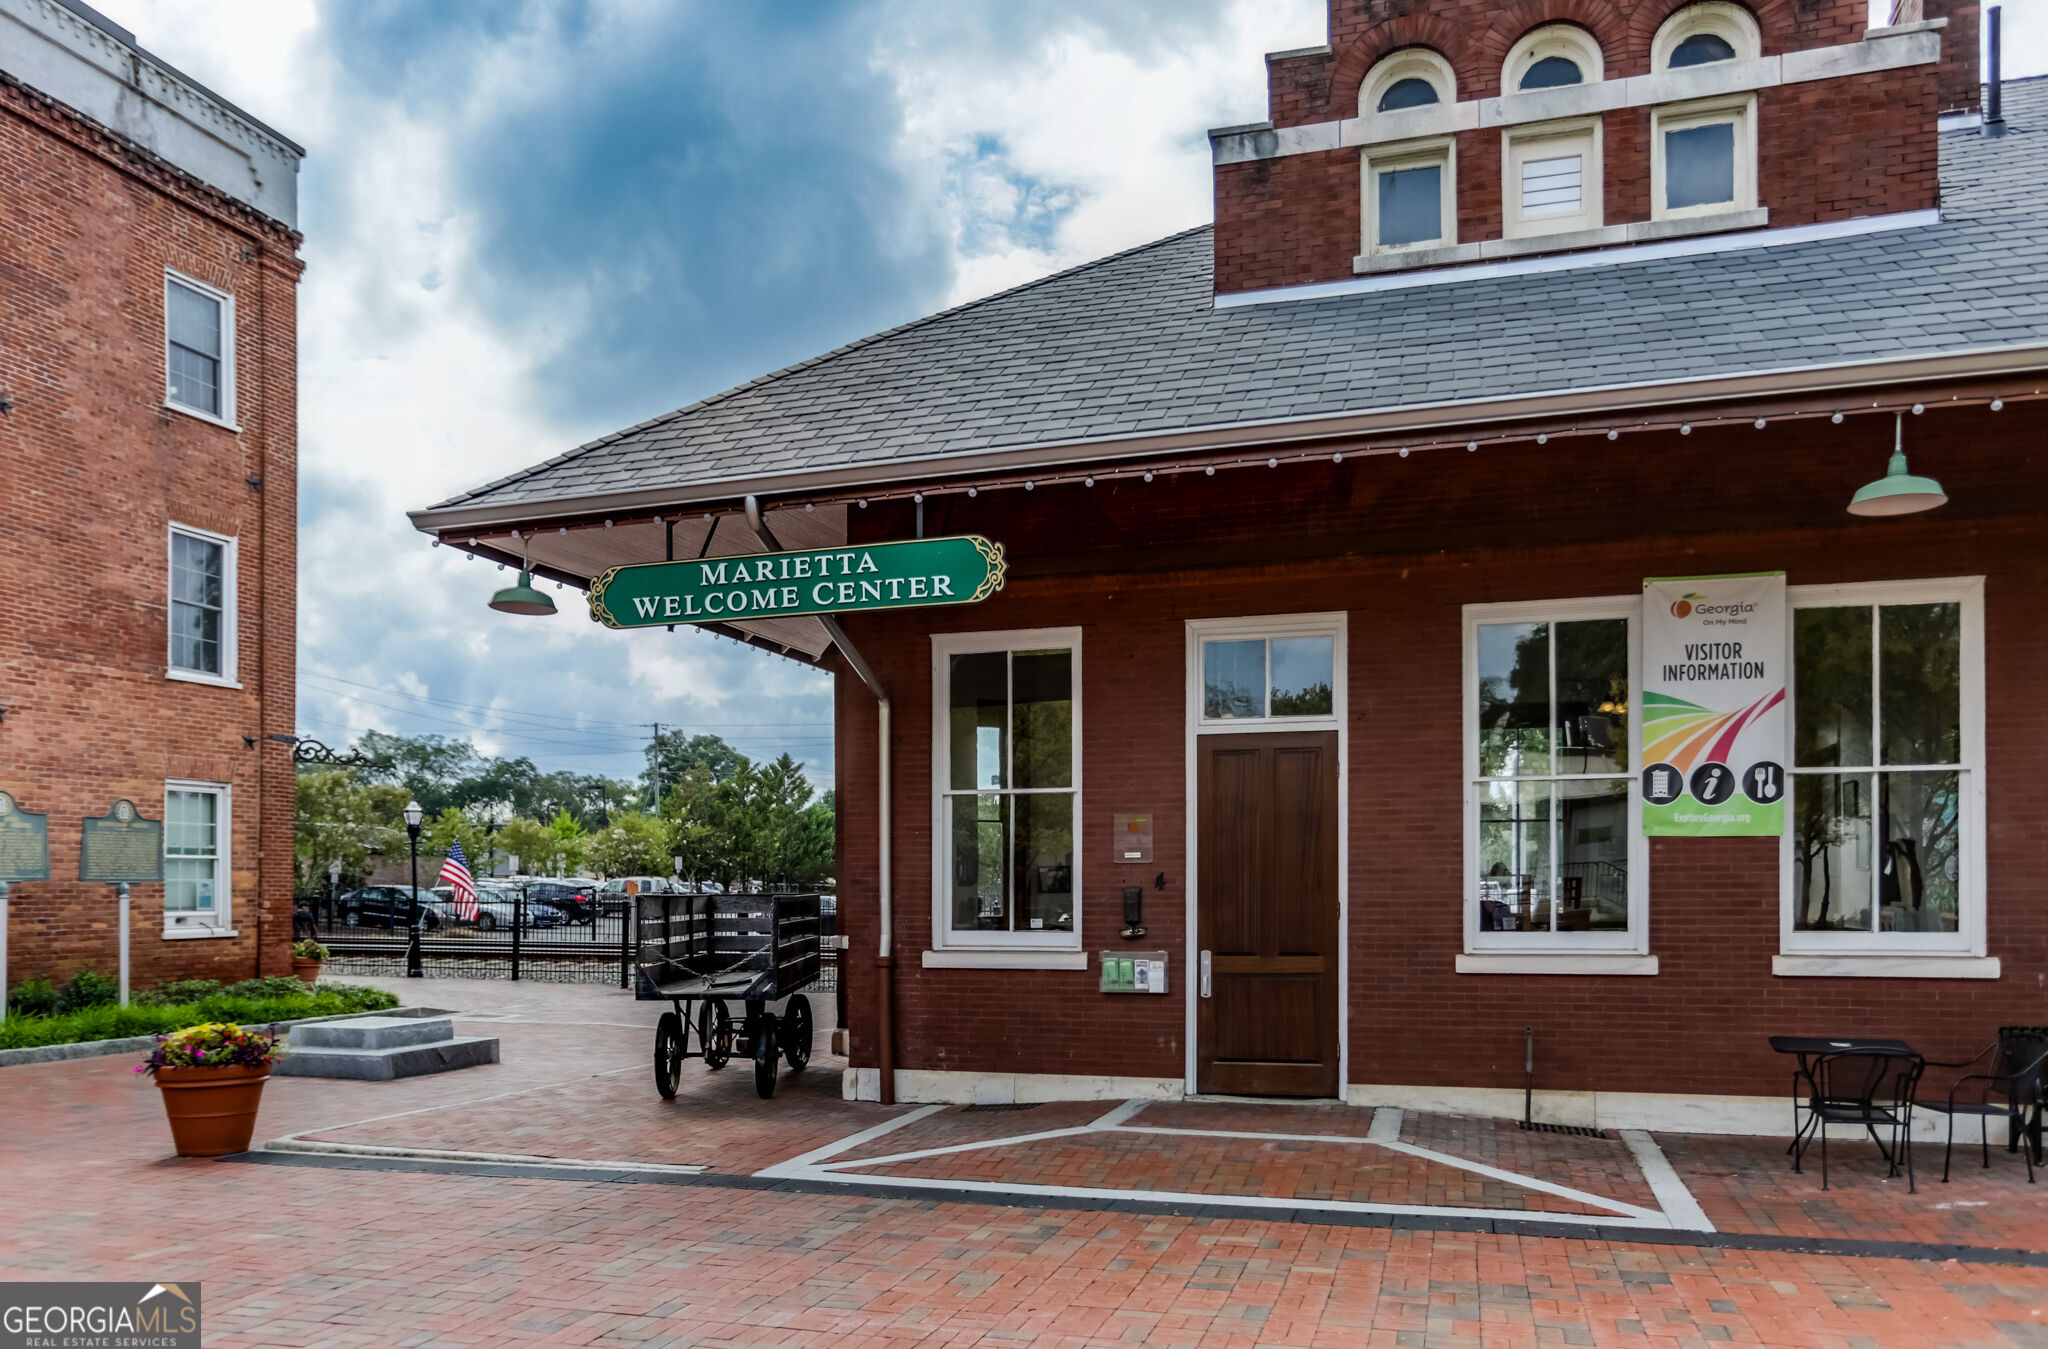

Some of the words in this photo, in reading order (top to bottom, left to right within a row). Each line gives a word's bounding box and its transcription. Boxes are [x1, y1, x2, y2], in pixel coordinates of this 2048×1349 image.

[700, 552, 878, 586] MARIETTA
[633, 586, 799, 619] WELCOME
[812, 575, 955, 606] CENTER
[1695, 601, 1755, 616] Georgia
[1685, 642, 1742, 661] VISITOR
[1663, 662, 1764, 682] INFORMATION
[1674, 812, 1751, 824] ExploreGeorgia.org
